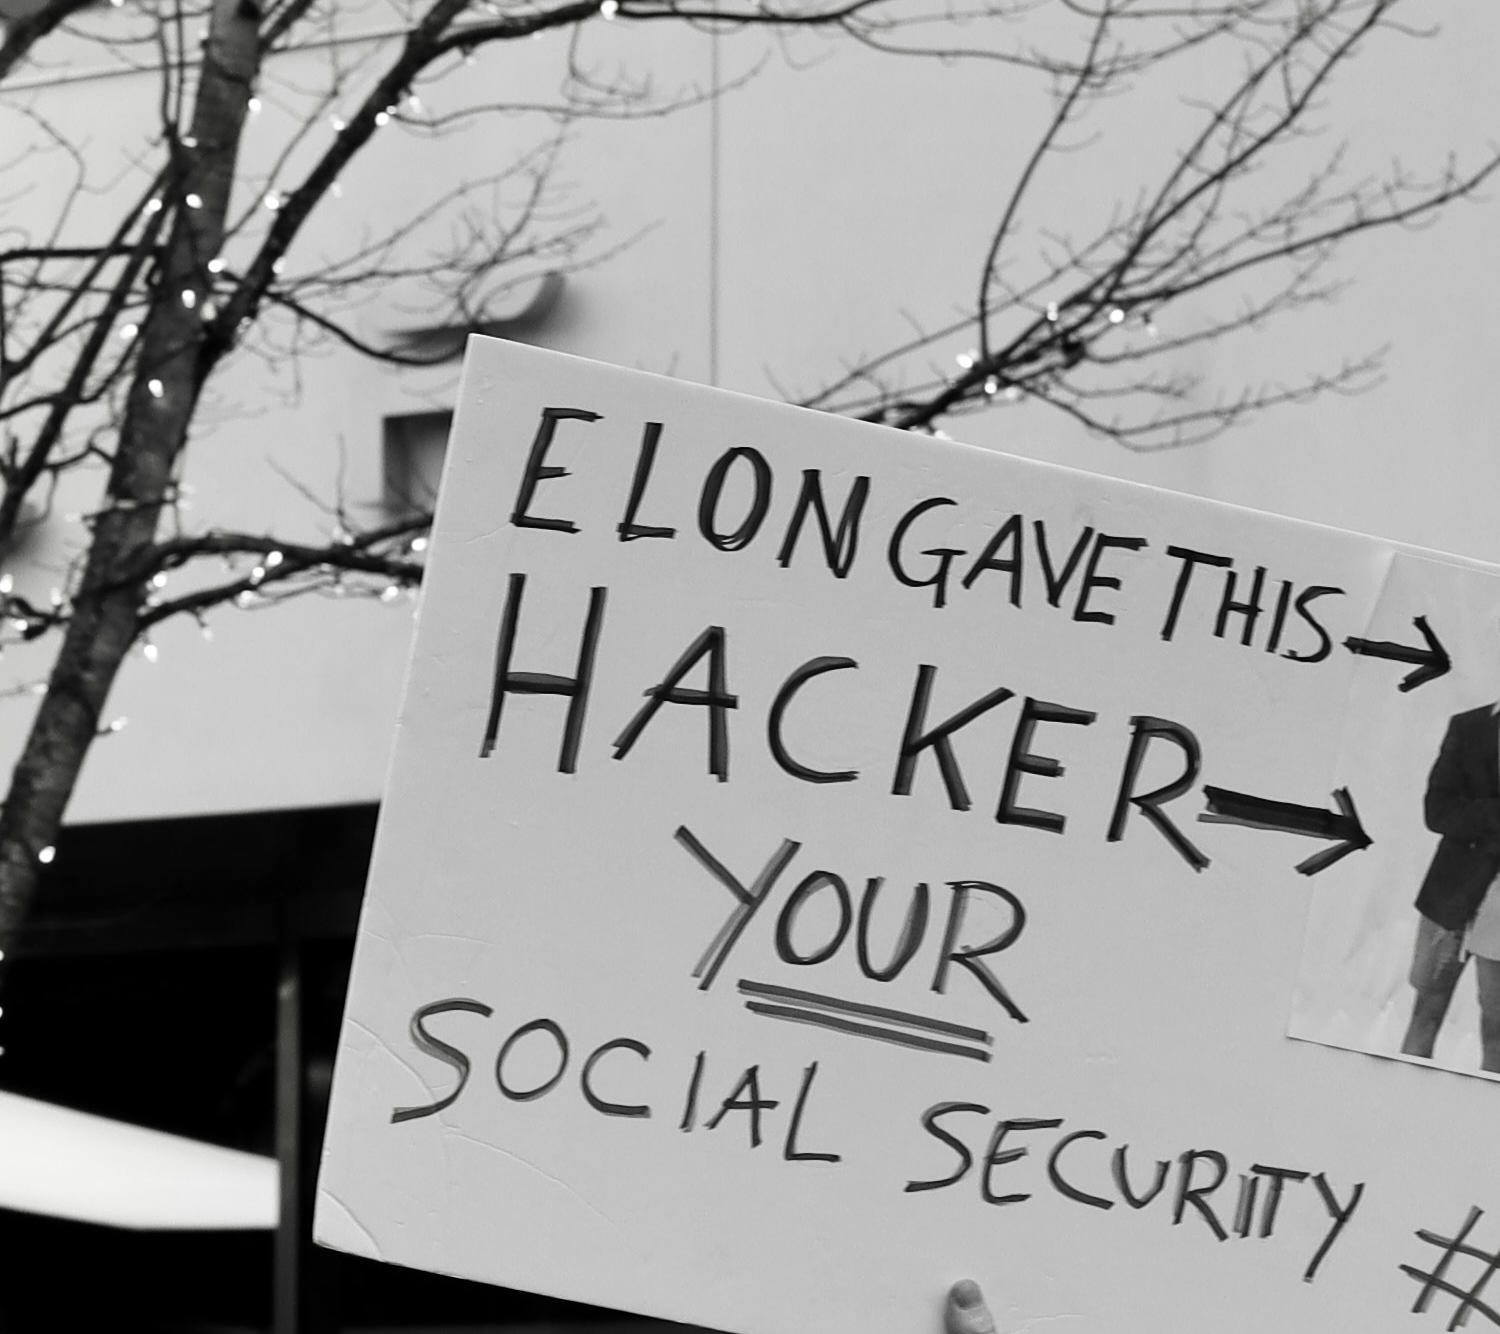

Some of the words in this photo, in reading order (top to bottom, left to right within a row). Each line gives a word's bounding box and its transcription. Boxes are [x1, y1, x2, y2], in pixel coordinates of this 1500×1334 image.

[510, 406, 870, 576] ELON
[887, 496, 1147, 625] GAVE
[1164, 545, 1344, 662] THIS
[479, 573, 1210, 872] HACKER
[674, 827, 1028, 1022] YOUR
[391, 998, 841, 1163] SOCIAL
[905, 1101, 1365, 1282] SECURITY
